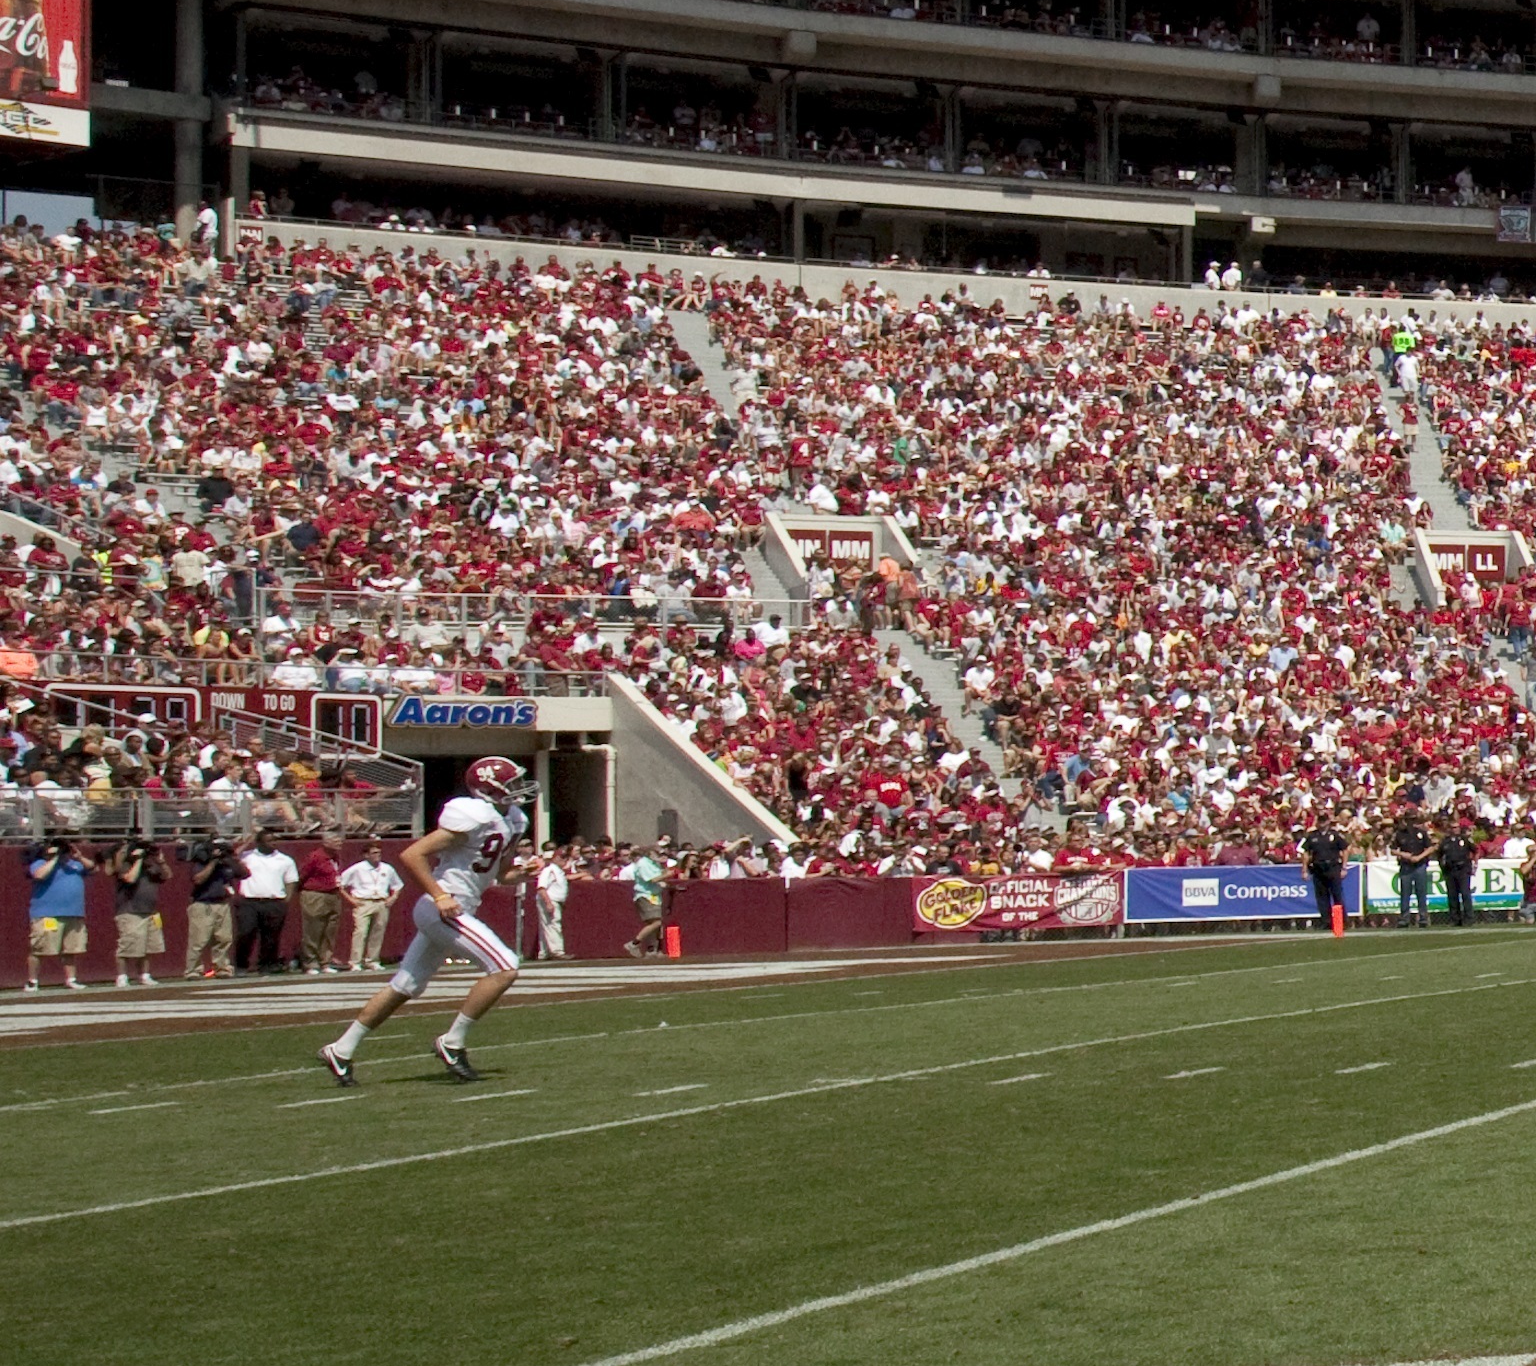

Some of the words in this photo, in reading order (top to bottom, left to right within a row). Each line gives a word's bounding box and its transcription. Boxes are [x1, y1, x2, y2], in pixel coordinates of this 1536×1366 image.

[832, 539, 870, 559] MM
[1476, 553, 1498, 571] LL
[211, 692, 244, 710] DOWN
[262, 693, 278, 711] TO
[279, 693, 295, 712] GO
[390, 695, 536, 727] Aaron's
[474, 765, 493, 782] 94
[924, 886, 982, 908] GOLDEN
[990, 893, 1050, 910] SNACK
[1185, 887, 1215, 898] BBVA
[1224, 884, 1308, 901] Compass
[933, 898, 978, 920] FLAKE
[1002, 912, 1015, 922] OF
[1018, 910, 1039, 922] THE
